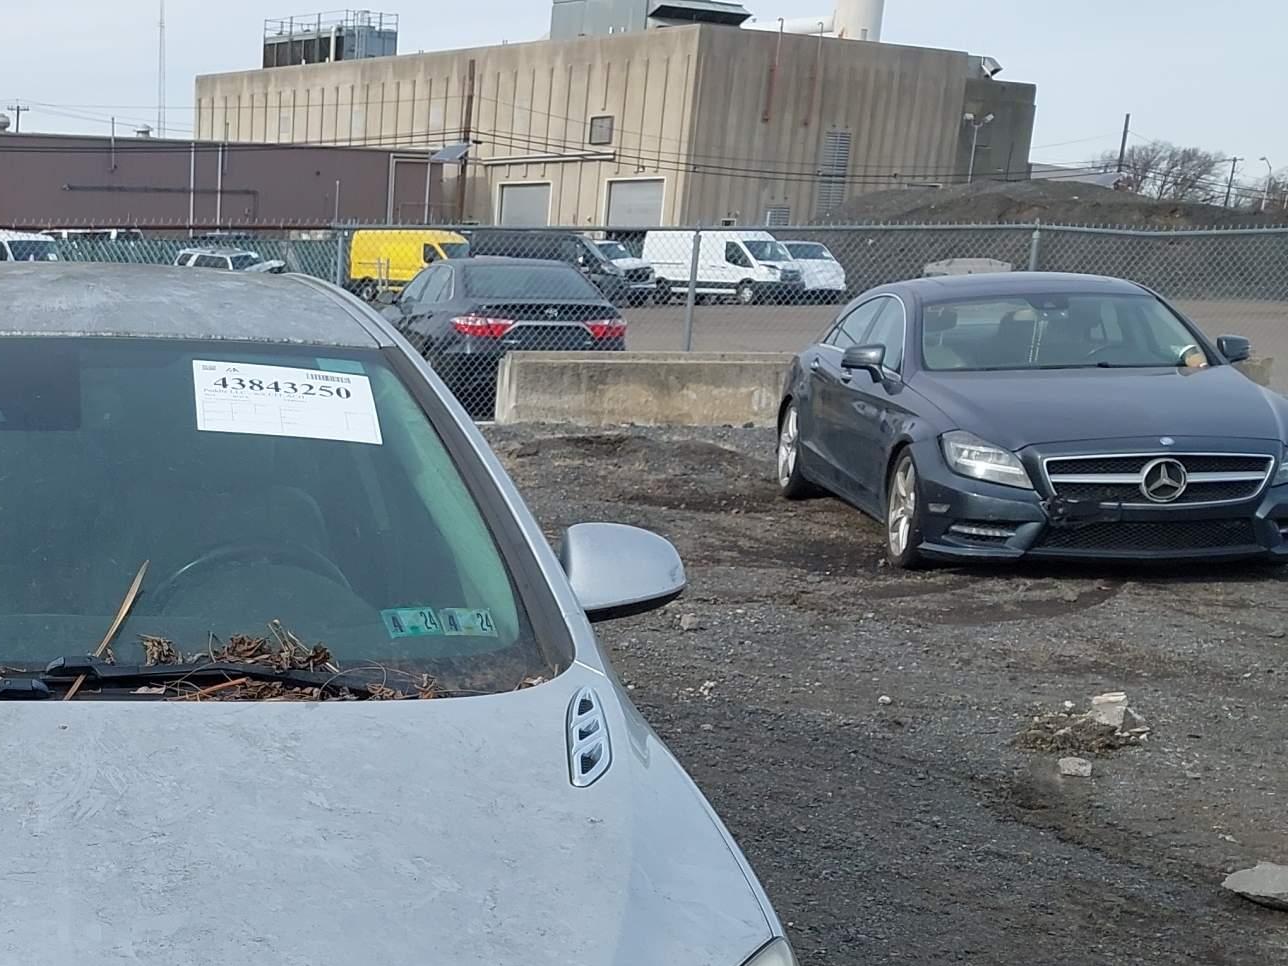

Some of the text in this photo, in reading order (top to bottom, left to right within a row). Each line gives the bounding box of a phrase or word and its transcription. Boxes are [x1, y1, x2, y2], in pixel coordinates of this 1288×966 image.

[213, 376, 352, 400] 43843250
[419, 611, 438, 630] 24
[476, 612, 494, 631] 24
